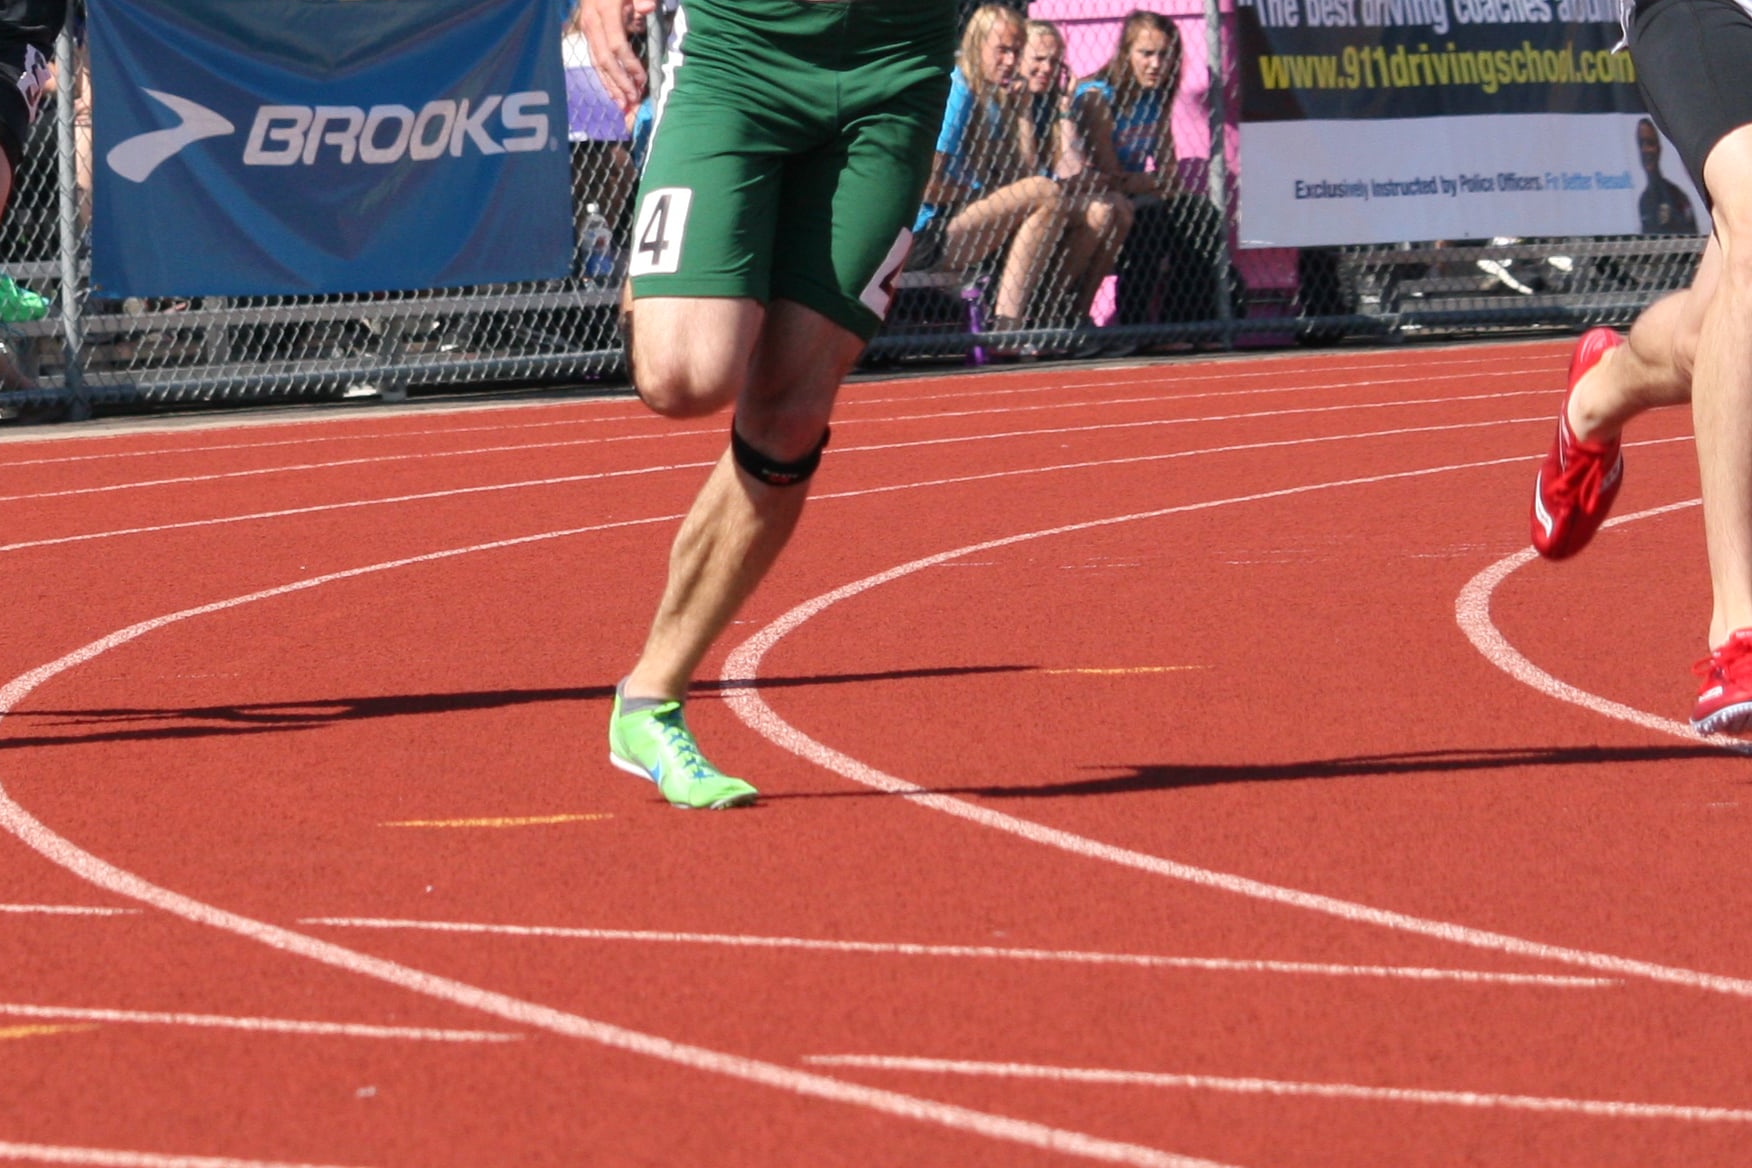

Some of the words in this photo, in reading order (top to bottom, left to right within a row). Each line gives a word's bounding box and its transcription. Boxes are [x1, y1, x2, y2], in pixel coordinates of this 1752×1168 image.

[243, 90, 551, 167] BROOKS
[1370, 175, 1438, 198] Instructed
[1439, 174, 1458, 198] by
[1459, 173, 1495, 193] Police
[638, 193, 672, 266] 4
